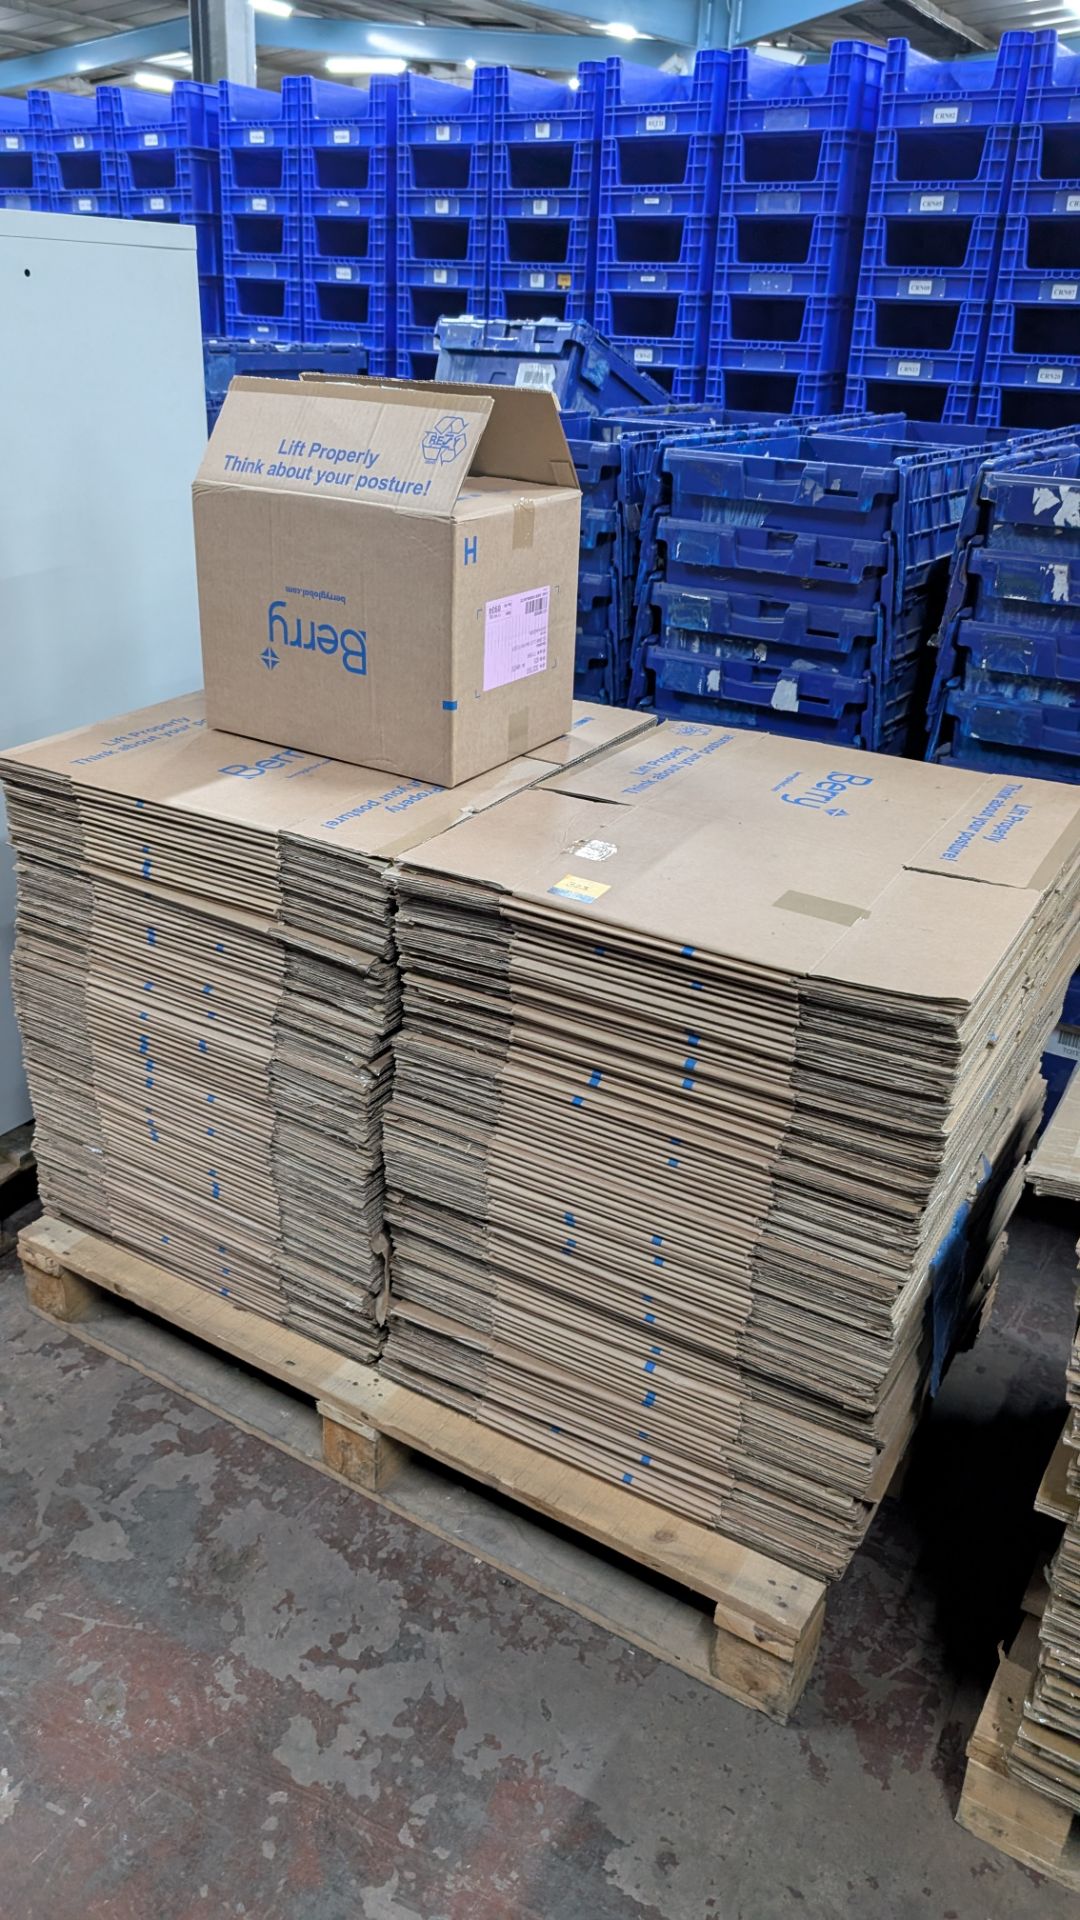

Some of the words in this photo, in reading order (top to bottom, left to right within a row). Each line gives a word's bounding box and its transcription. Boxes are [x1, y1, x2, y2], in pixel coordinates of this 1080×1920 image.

[278, 439, 307, 456] Lift
[308, 442, 381, 469] Properly
[223, 454, 263, 475] Think
[267, 461, 312, 481] about
[313, 468, 354, 487] your
[355, 473, 433, 497] posture!
[464, 535, 478, 566] H
[285, 586, 346, 605] berryglobal.com
[268, 600, 367, 675] Berry
[69, 749, 118, 765] Think
[118, 735, 161, 751] about
[159, 724, 192, 737] your
[652, 764, 684, 780] about
[679, 752, 702, 767] your
[781, 771, 873, 809] Berry
[995, 783, 1024, 800] Think
[320, 799, 381, 830] posture!
[979, 799, 1008, 817] about
[1008, 803, 1033, 815] Lift
[966, 816, 991, 833] your
[983, 814, 1025, 843] Properly
[940, 831, 976, 862] posture!
